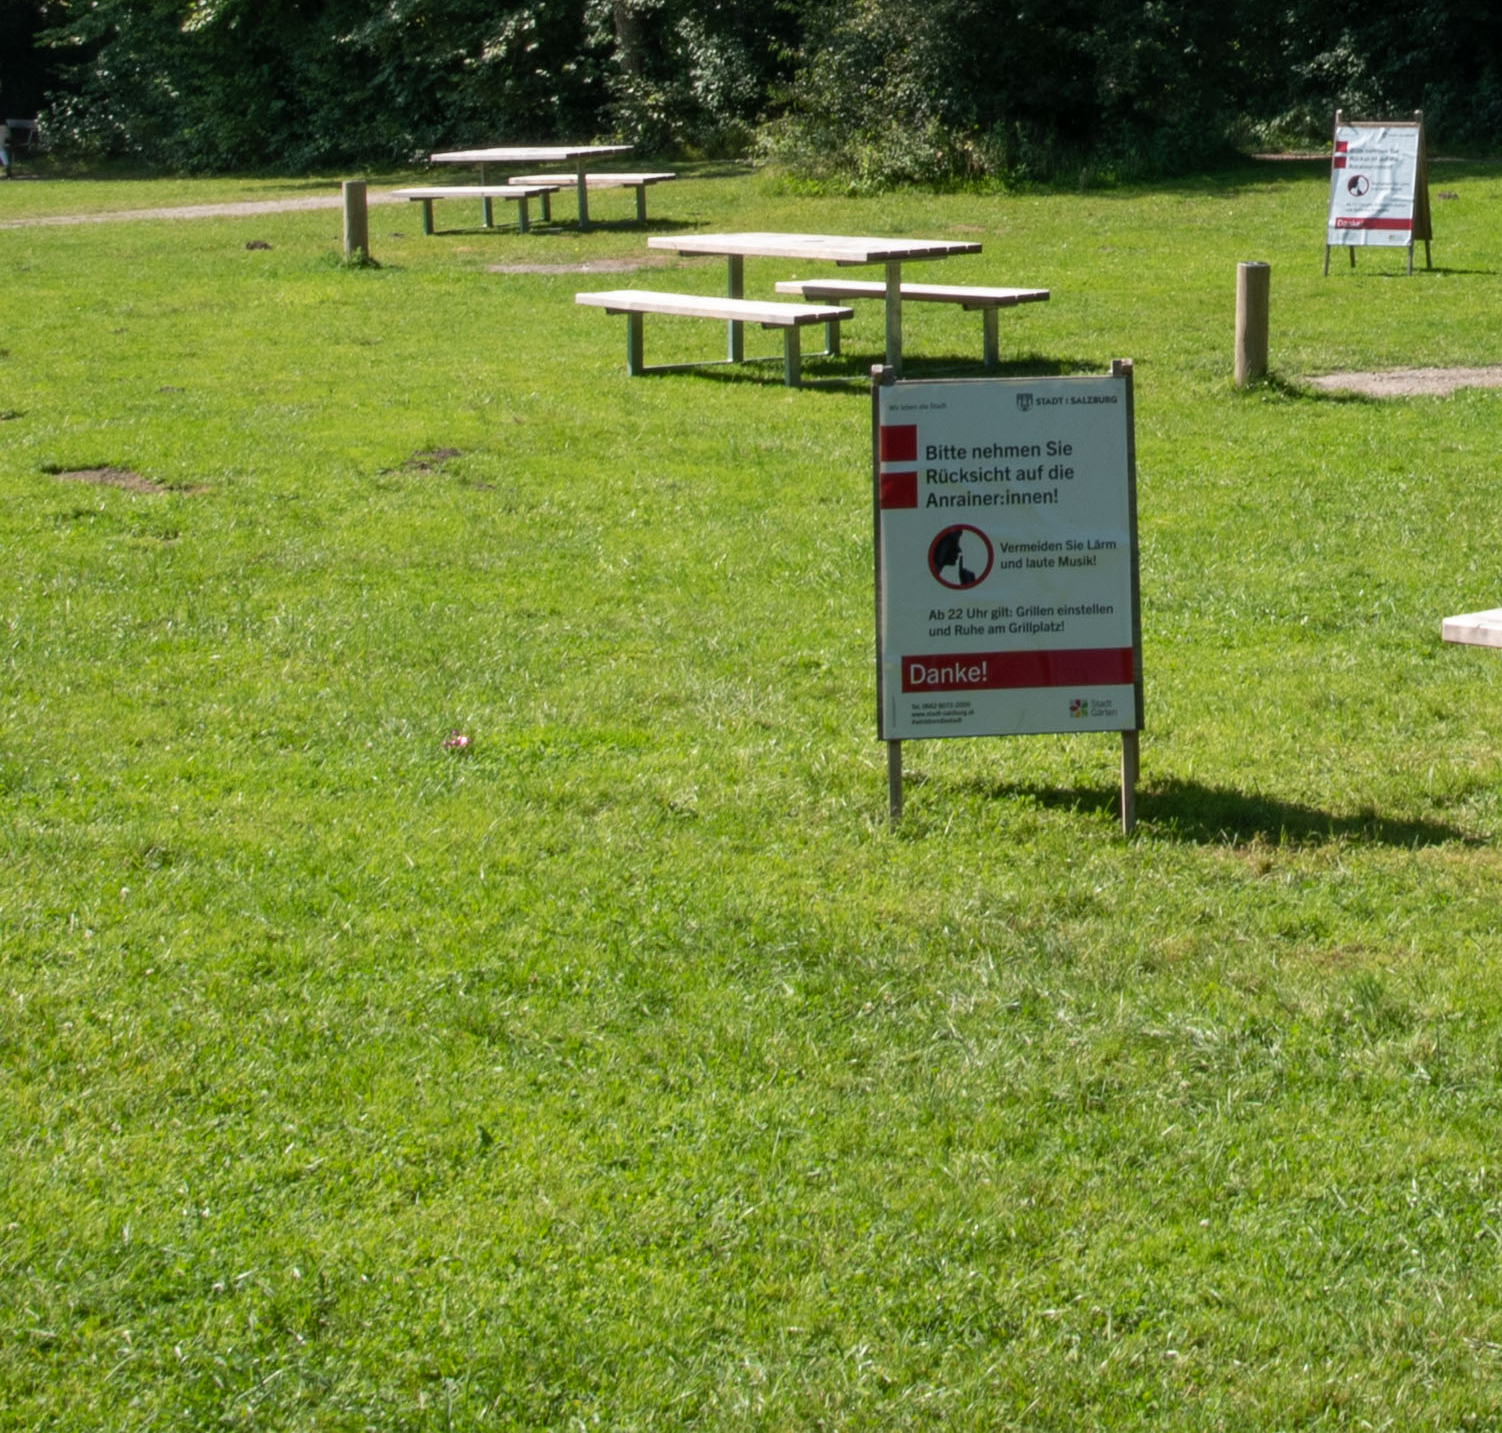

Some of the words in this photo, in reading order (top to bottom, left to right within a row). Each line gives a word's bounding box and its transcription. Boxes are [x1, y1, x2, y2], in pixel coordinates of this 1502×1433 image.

[1036, 397, 1063, 406] STADT
[1070, 395, 1118, 405] SALZBURG
[926, 445, 967, 461] Bitte
[972, 443, 1041, 459] nehmen
[1046, 440, 1073, 457] Sie
[926, 467, 1011, 484] Rücksicht
[1016, 466, 1044, 481] auf
[1048, 465, 1074, 480] die
[925, 489, 1058, 508] Anrainer:innen!
[1000, 541, 1062, 553] Vermeiden
[1065, 540, 1084, 551] Sie
[1087, 539, 1117, 550] Lärm
[1000, 558, 1023, 569] und
[1026, 557, 1055, 568] laute
[1058, 555, 1097, 567] Musik!
[928, 609, 945, 621] Ab
[947, 609, 963, 620] 22
[966, 608, 987, 619] Uhr
[990, 607, 1013, 621] gilt:
[1015, 606, 1054, 617] Grillen
[1057, 604, 1114, 616] einstellen
[928, 626, 951, 637] und
[954, 625, 984, 636] Ruhe
[987, 624, 1006, 635] am
[1008, 622, 1065, 635] Grillplatz!
[910, 661, 987, 685] Danke!
